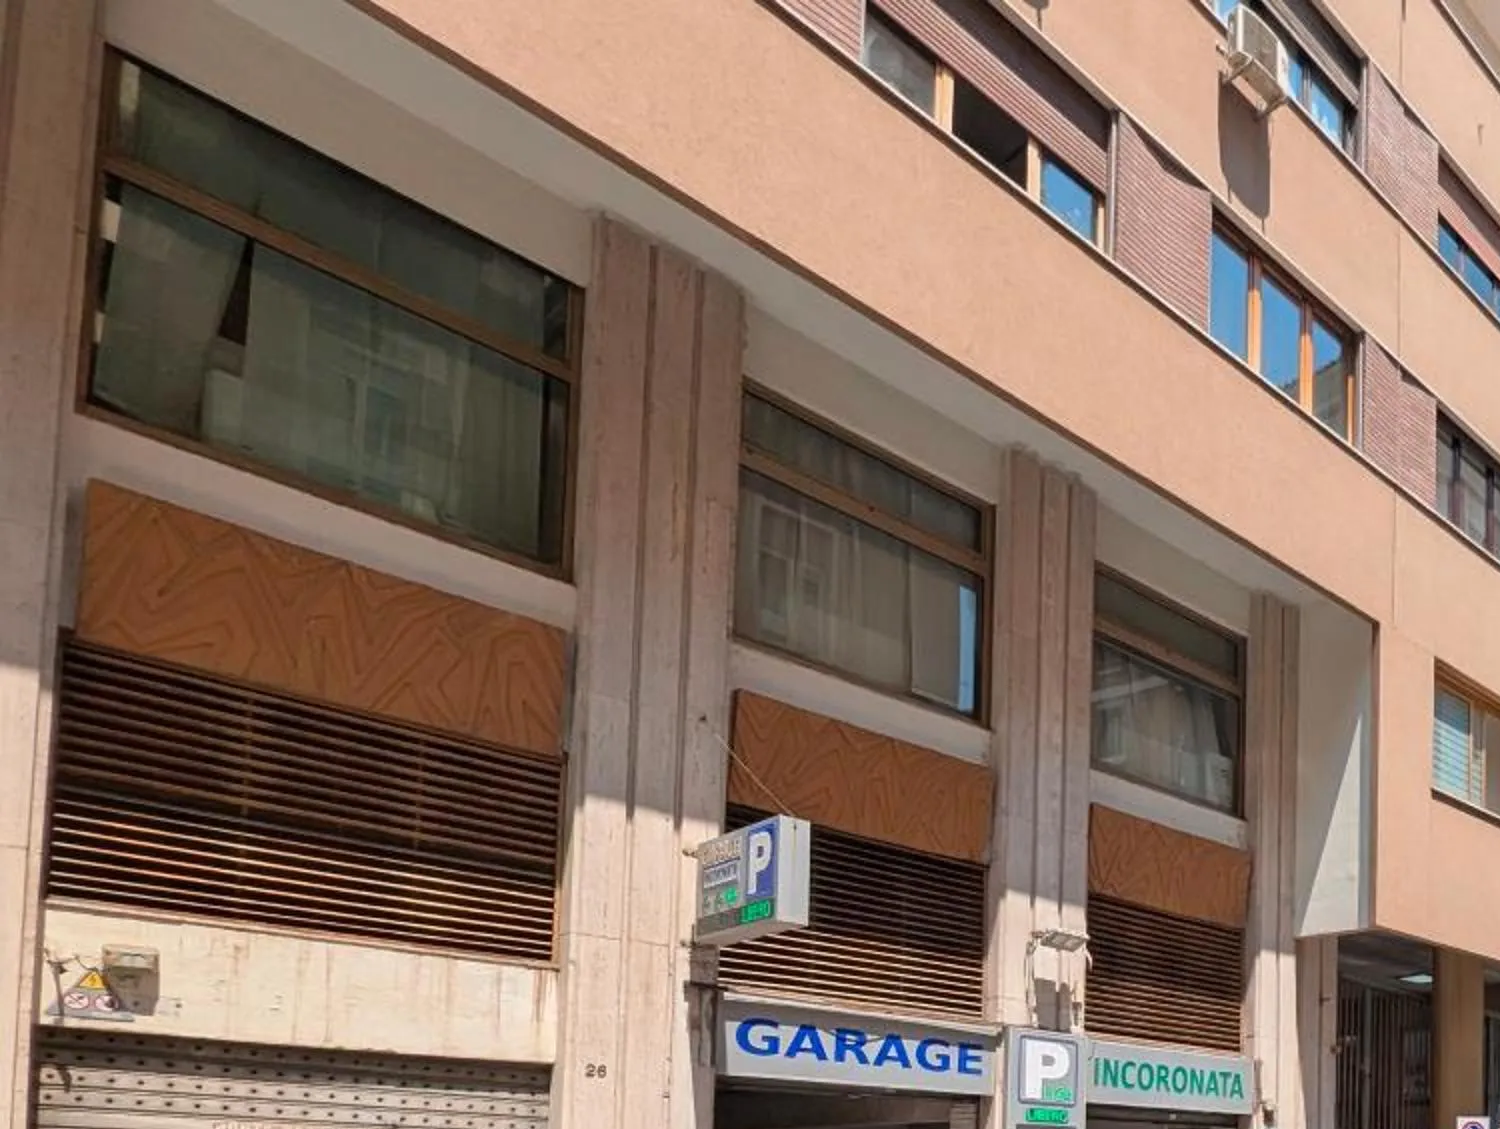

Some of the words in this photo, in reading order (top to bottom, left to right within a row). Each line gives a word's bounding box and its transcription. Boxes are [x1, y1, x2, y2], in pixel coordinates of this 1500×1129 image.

[747, 831, 772, 895] P
[735, 1017, 984, 1076] GARAGE
[1025, 1039, 1070, 1099] P
[1093, 1056, 1246, 1099] INCORONATA
